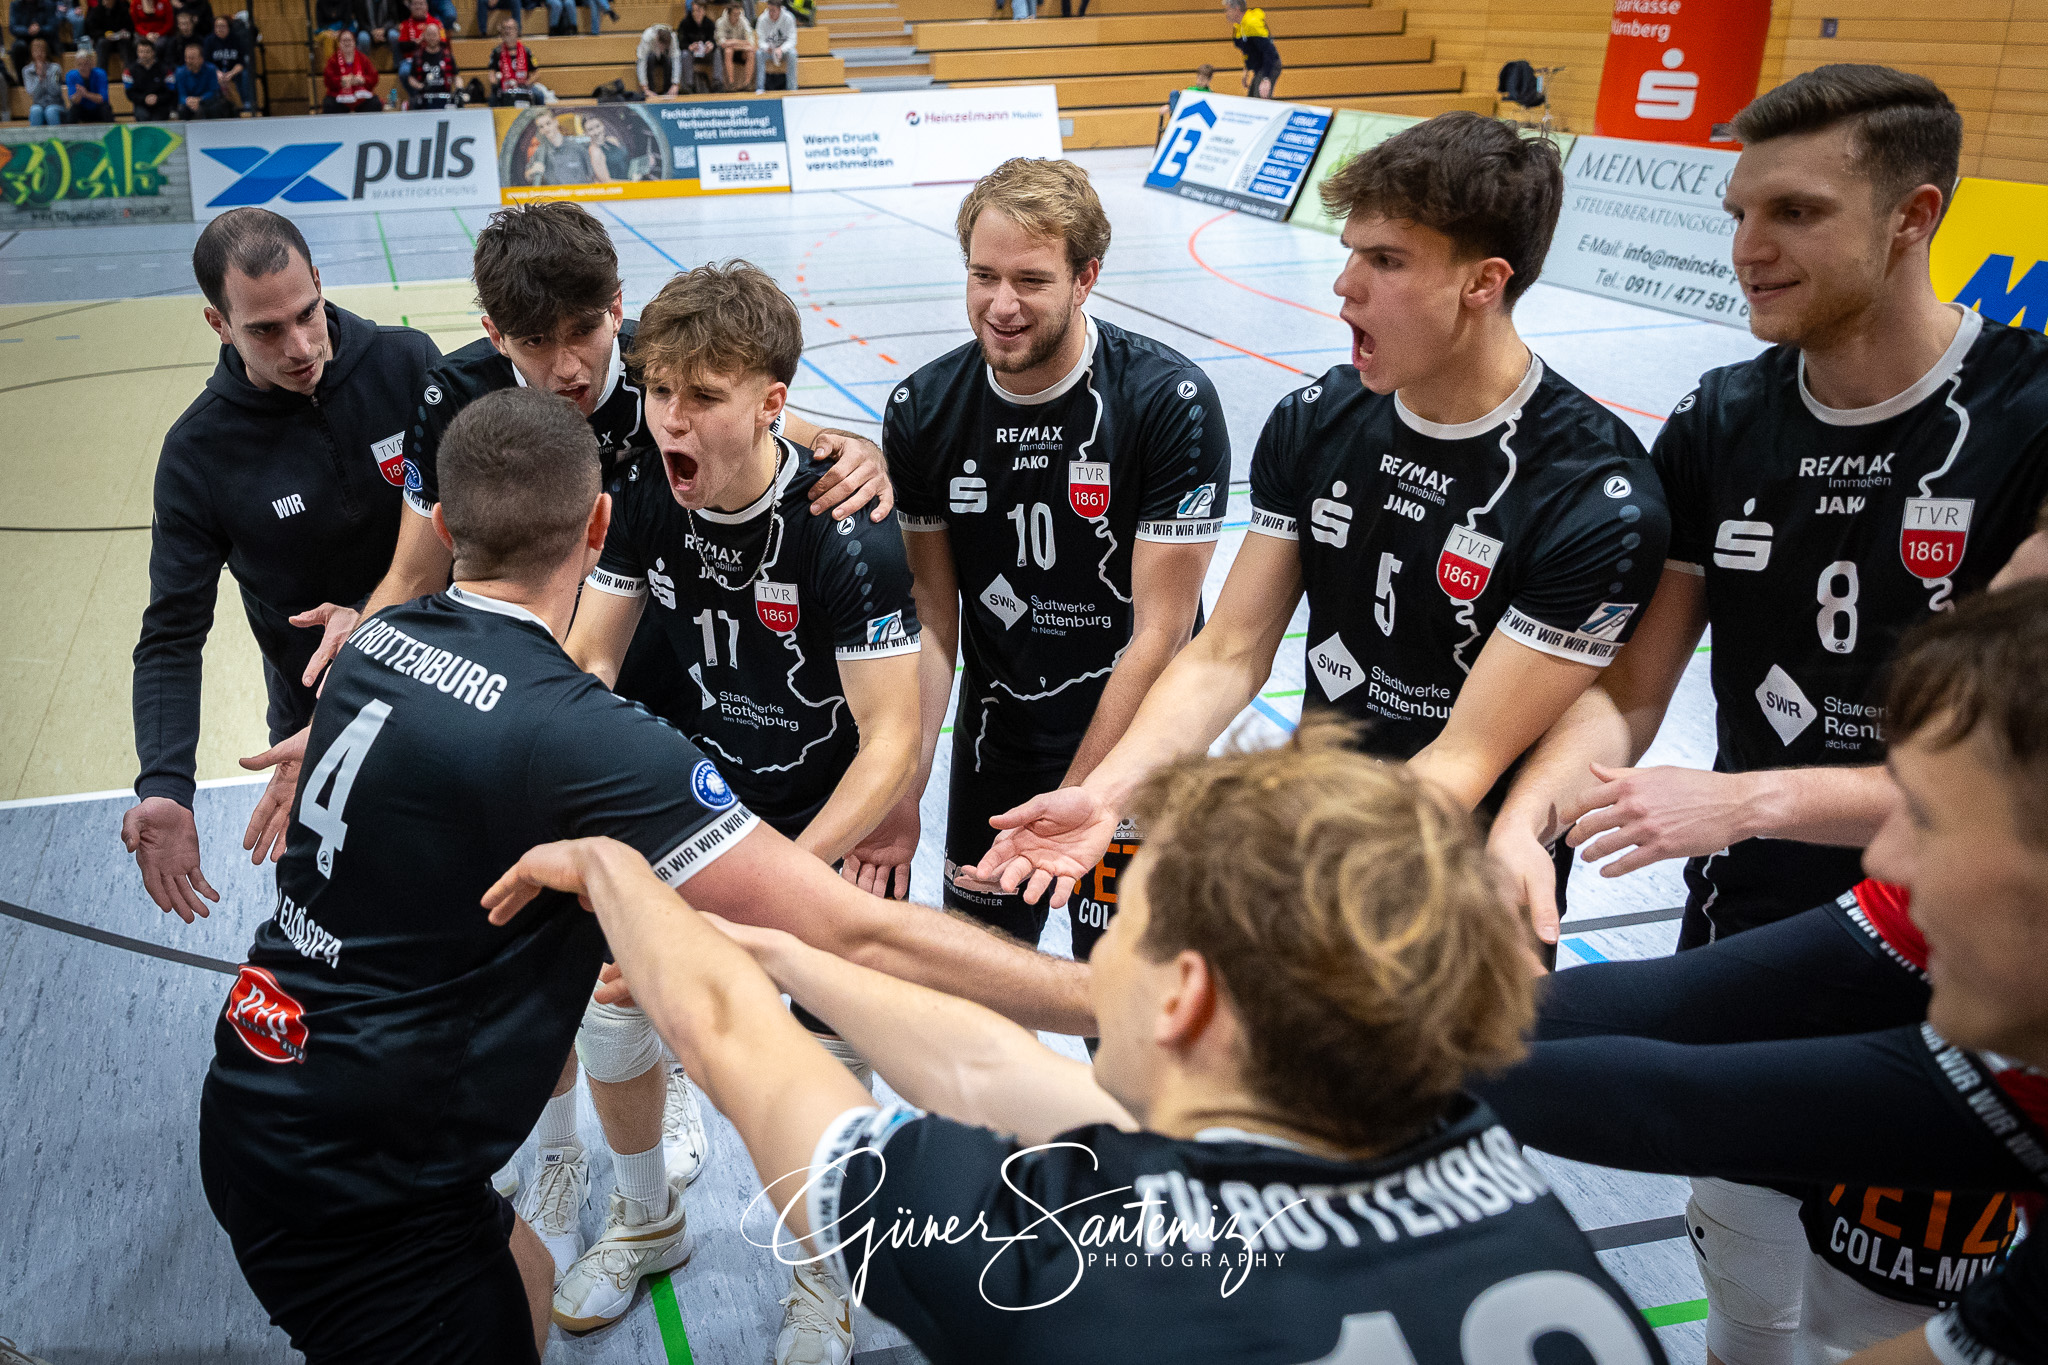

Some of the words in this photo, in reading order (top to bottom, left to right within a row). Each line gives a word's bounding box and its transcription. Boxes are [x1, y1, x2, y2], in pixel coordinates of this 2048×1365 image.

[924, 112, 1009, 124] Heinzelmann
[803, 134, 840, 145] Wenn
[843, 131, 880, 144] Druck
[353, 121, 475, 199] puls
[805, 148, 830, 158] und
[833, 146, 878, 159] Design
[807, 158, 894, 171] verschmelzen
[1576, 152, 1714, 195] MEINCKE
[1572, 194, 1737, 237] STEUERBERATUNGSGES
[1577, 233, 1622, 257] E-Mail:
[1625, 275, 1661, 298] 0911
[1674, 287, 1706, 307] 477
[1705, 292, 1738, 314] 581
[996, 426, 1063, 443] RE/MAX
[1020, 443, 1063, 452] Immobilien
[1012, 455, 1049, 471] JAKO
[1076, 466, 1105, 481] TVR
[1380, 453, 1455, 496] RE/MAX
[272, 493, 306, 520] WIR
[1074, 491, 1105, 506] 1861
[1397, 478, 1446, 507] Immobilien
[1261, 514, 1285, 530] WIR
[1383, 494, 1426, 522] JAKO
[1914, 506, 1959, 526] TVR
[1006, 502, 1056, 570] 10
[1153, 523, 1173, 536] WIR
[1175, 524, 1194, 537] WIR
[1196, 522, 1211, 535] WIR
[1456, 533, 1492, 562] TVR
[1908, 540, 1955, 562] 1861
[596, 573, 612, 586] WIR
[614, 578, 635, 591] WIR
[1443, 562, 1481, 591] 1861
[761, 586, 792, 602] TVR
[989, 593, 1017, 613] SWR
[1030, 594, 1096, 613] Sadtwerke
[1373, 551, 1404, 637] 5
[1817, 560, 1859, 654] 8
[762, 608, 794, 623] 1861
[1508, 614, 1536, 637] WIR
[1537, 627, 1564, 647] WIR
[1563, 635, 1589, 653] WIR
[1587, 642, 1611, 658] WIR
[354, 620, 508, 713] ROTTENBURG
[1317, 652, 1352, 681] SWR
[1371, 665, 1450, 699] Stadtwerke
[721, 703, 799, 731] Rottenburg
[1366, 701, 1379, 713] am
[1766, 690, 1802, 719] SWR
[299, 698, 393, 880] 4
[667, 847, 698, 872] WIR
[694, 828, 725, 853] WIR
[719, 811, 745, 834] WIR
[279, 895, 343, 969] ELSÄSSER
[1935, 1045, 1982, 1093] WIR
[1967, 1087, 2018, 1137] WIR
[545, 1153, 561, 1163] NIKE
[1134, 1171, 1213, 1256] TV
